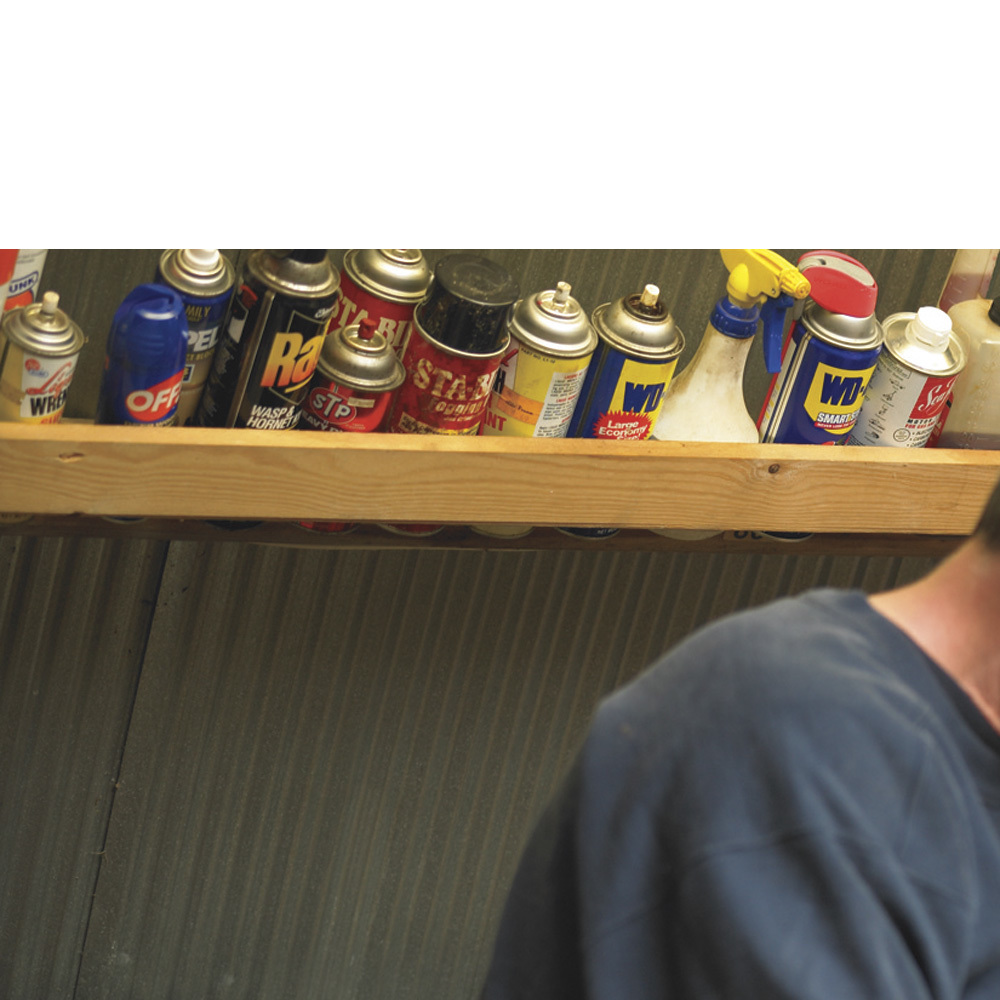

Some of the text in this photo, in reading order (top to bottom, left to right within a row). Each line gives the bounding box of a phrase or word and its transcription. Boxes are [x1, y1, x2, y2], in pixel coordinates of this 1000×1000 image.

[250, 404, 287, 419] WASP
[313, 393, 351, 418] STP
[246, 414, 296, 431] HORNET
[817, 412, 852, 424] SMART
[599, 424, 648, 436] Economy
[608, 420, 639, 430] Large
